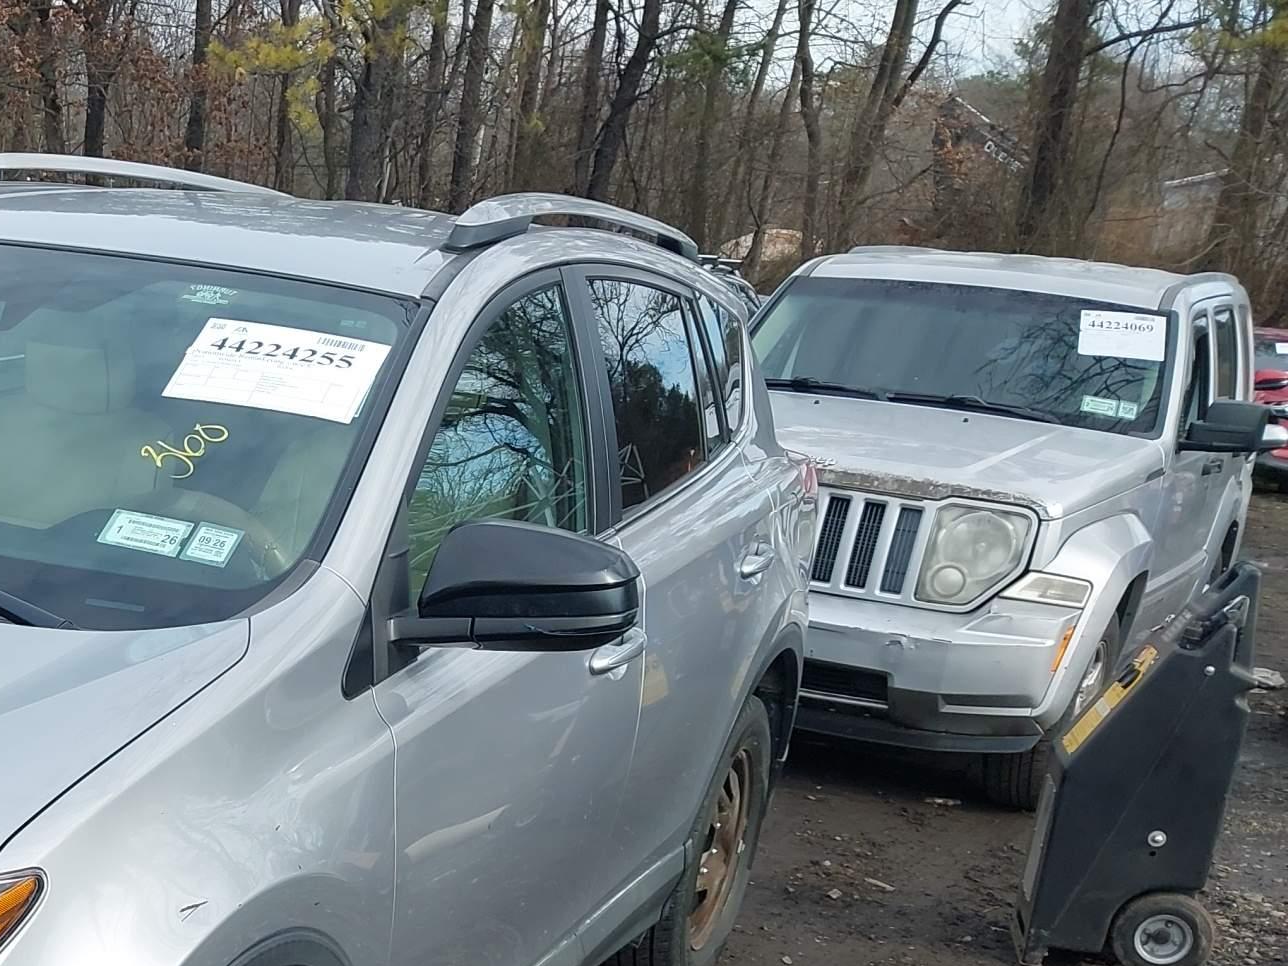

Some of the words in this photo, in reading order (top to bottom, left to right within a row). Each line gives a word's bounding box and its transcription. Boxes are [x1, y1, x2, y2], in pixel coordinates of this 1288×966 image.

[1088, 320, 1154, 333] 44224069
[210, 336, 355, 369] 44224255
[140, 423, 229, 480] 360
[160, 534, 179, 546] 26
